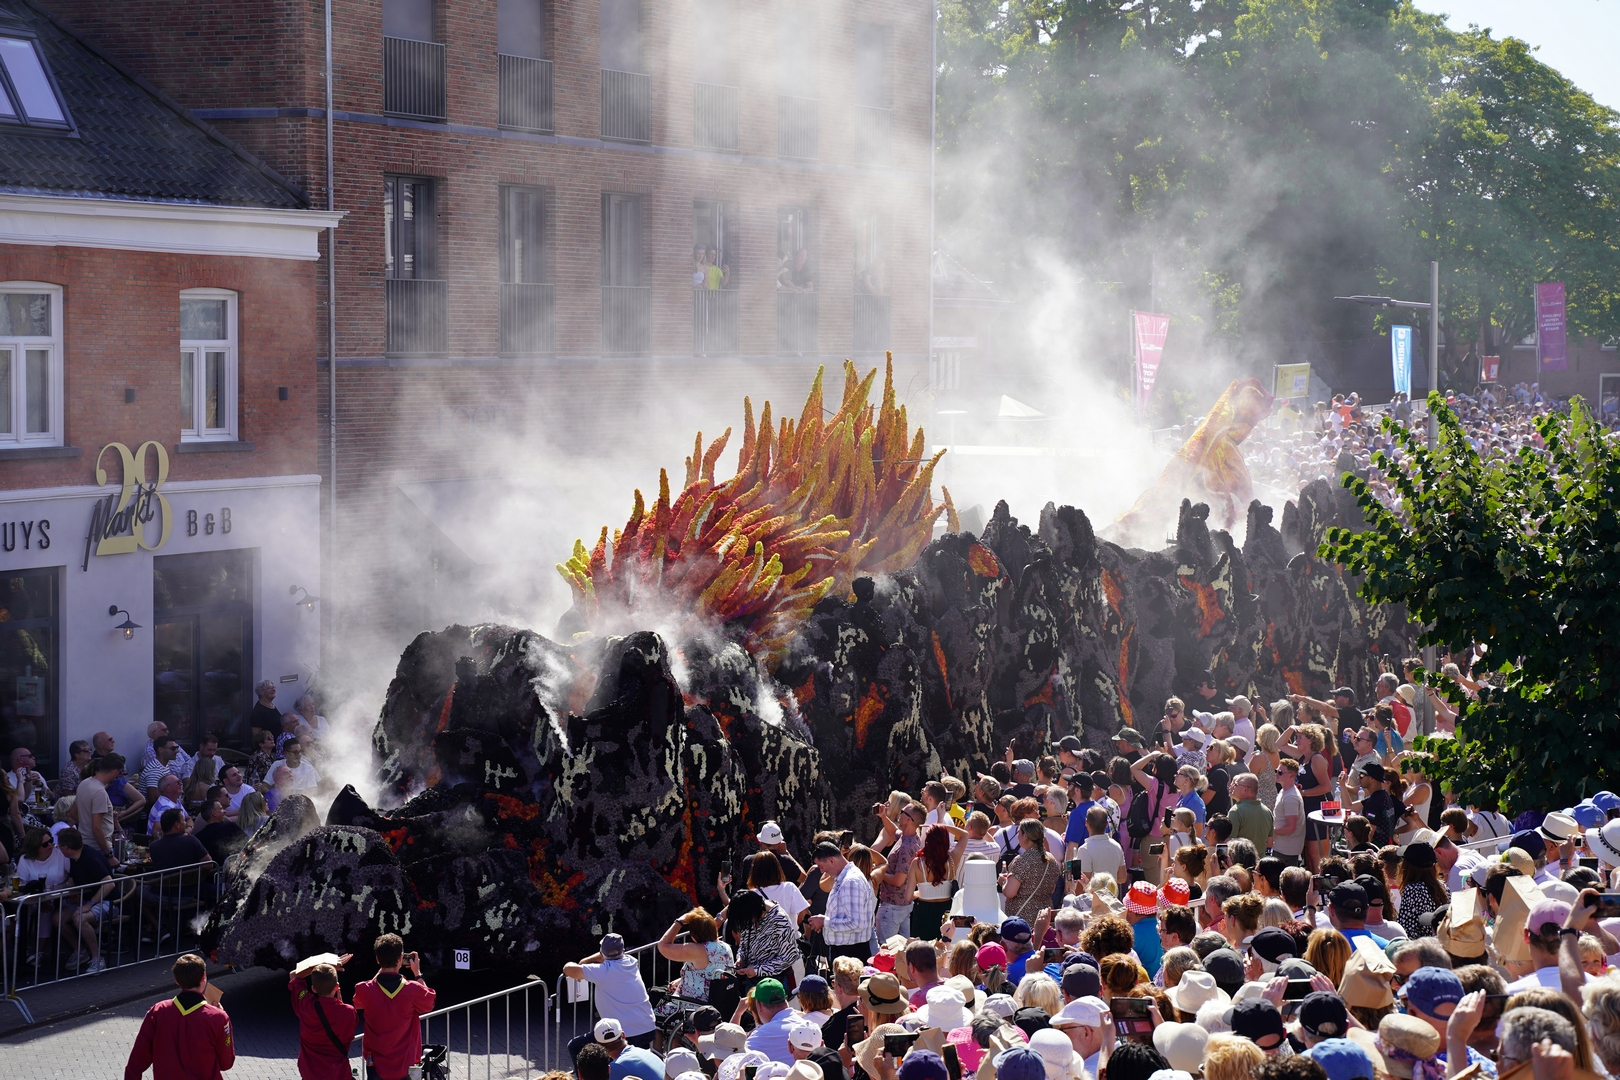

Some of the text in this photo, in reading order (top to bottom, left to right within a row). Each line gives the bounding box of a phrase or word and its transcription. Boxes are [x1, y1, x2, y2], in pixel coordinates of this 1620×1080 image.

[82, 483, 158, 572] Markt
[96, 440, 173, 556] 28
[2, 519, 50, 552] UYS
[456, 952, 469, 963] 08
